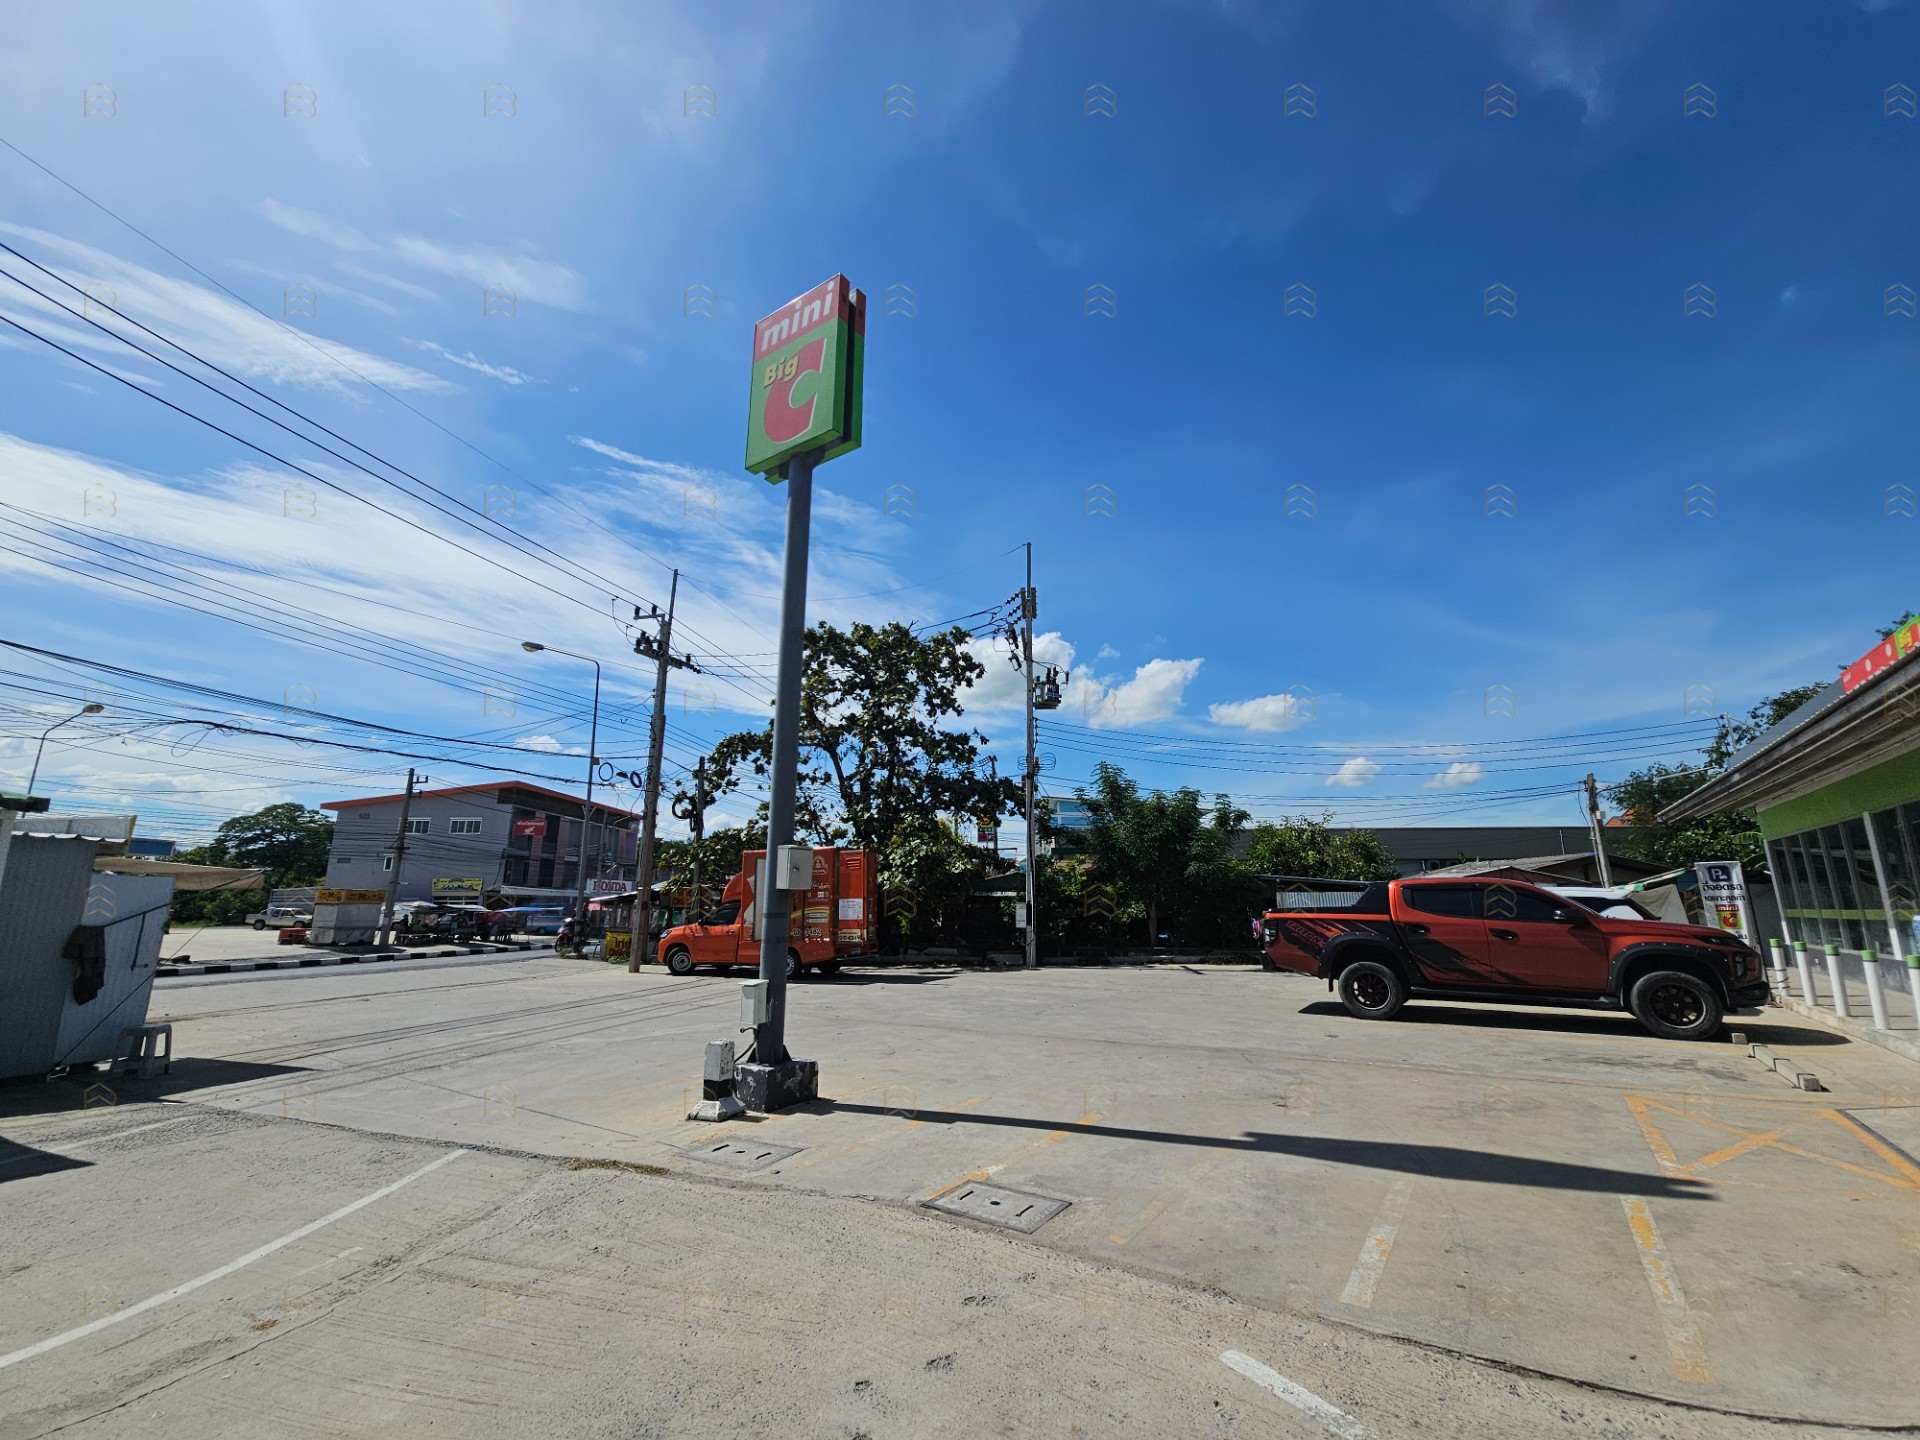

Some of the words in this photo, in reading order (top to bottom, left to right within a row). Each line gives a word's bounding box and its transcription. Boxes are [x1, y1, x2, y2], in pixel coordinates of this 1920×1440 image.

[762, 280, 835, 350] mini
[763, 338, 827, 443] C
[764, 354, 800, 389] Big
[1711, 868, 1722, 880] P
